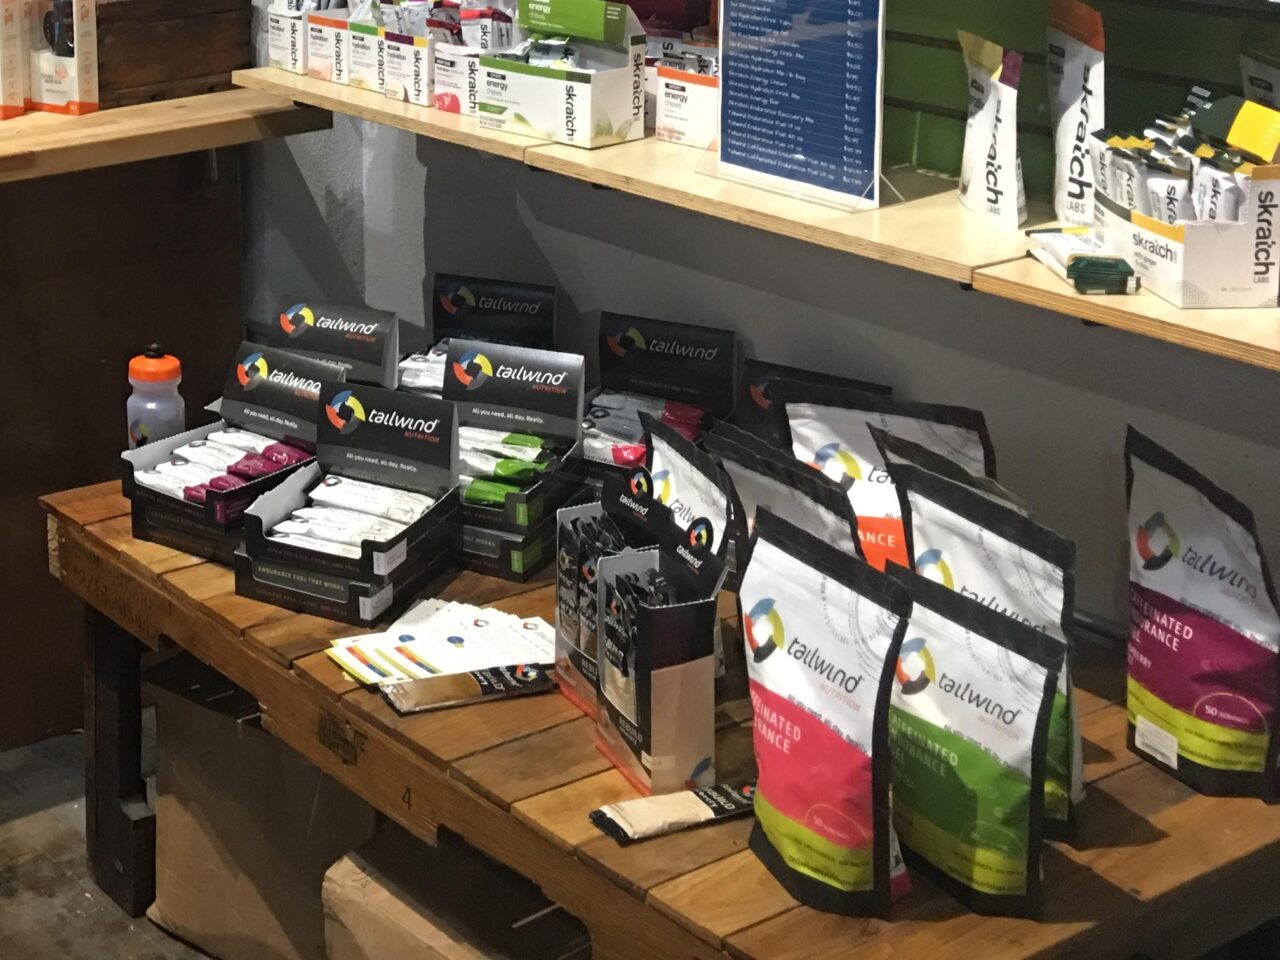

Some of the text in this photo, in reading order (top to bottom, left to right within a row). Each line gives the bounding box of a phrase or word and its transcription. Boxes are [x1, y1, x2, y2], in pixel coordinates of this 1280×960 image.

[528, 2, 551, 14] energy
[290, 21, 298, 67] skratch
[334, 31, 344, 77] skratch
[377, 39, 385, 85] skratch
[413, 49, 423, 96] skratch
[468, 59, 479, 110] skratch
[486, 80, 508, 91] energy
[632, 51, 643, 118] skratch
[664, 91, 688, 104] energy
[565, 83, 577, 138] skratch
[1067, 63, 1094, 201] skratch
[1067, 202, 1086, 214] LABS
[1132, 232, 1173, 261] skratch
[1254, 190, 1280, 276] skratch
[478, 296, 541, 315] tailwind
[316, 316, 378, 335] tailwind
[649, 338, 718, 363] tailwind
[496, 364, 568, 386] tailwind
[368, 408, 440, 433] tailwind
[620, 494, 648, 515] tailwind
[676, 545, 703, 568] tailwind
[787, 636, 863, 694] tailwind
[939, 672, 1020, 725] tailwind
[1204, 704, 1218, 717] 50
